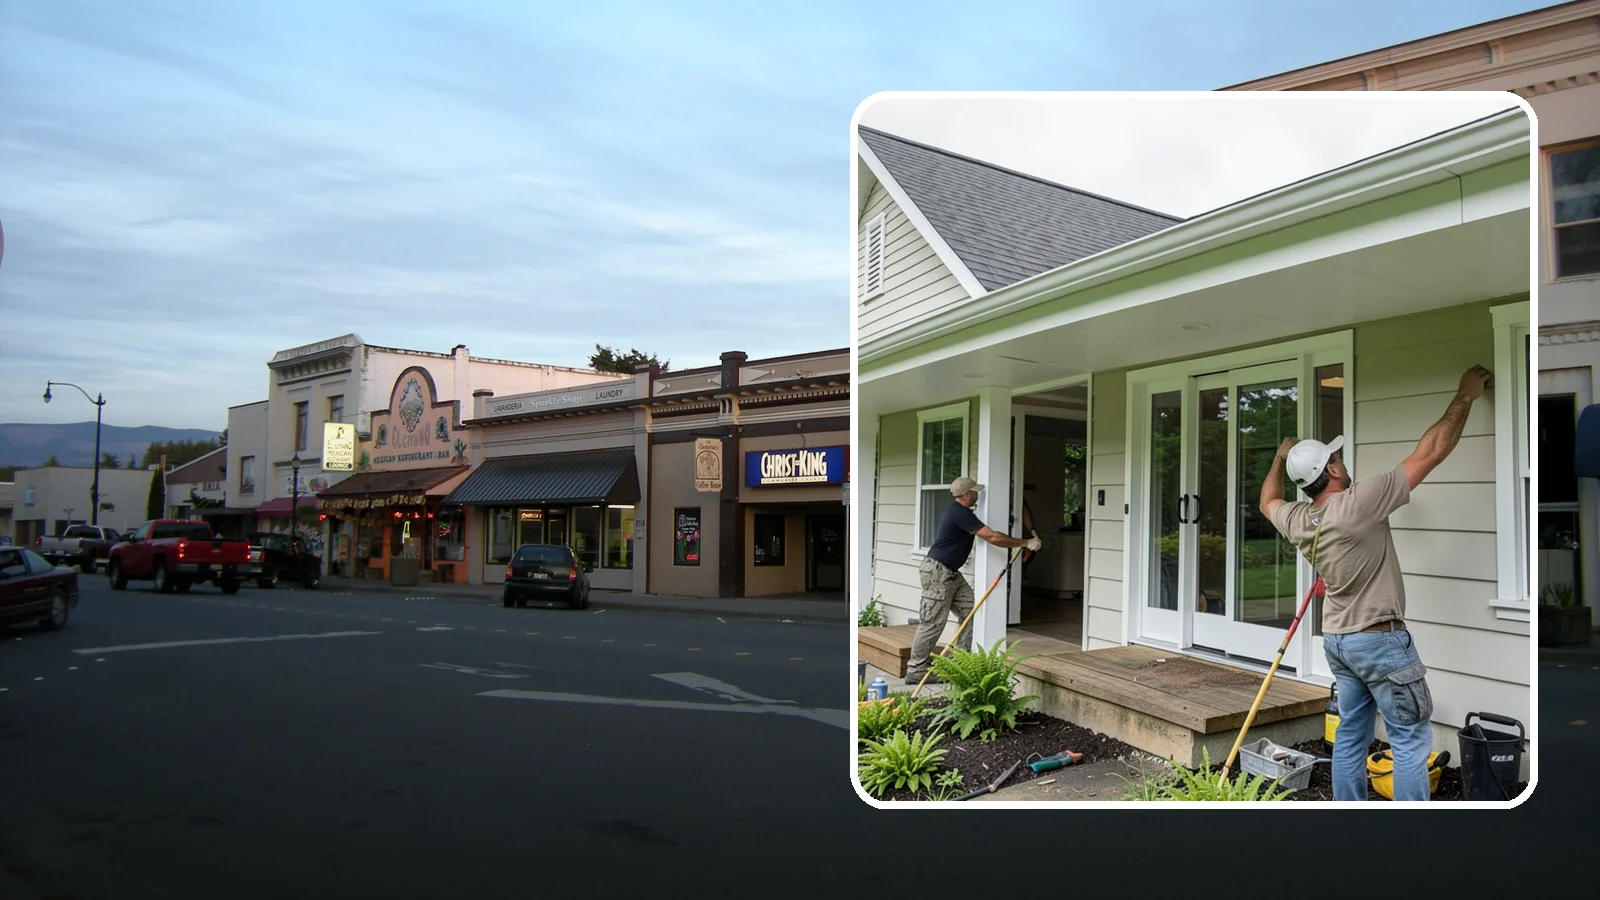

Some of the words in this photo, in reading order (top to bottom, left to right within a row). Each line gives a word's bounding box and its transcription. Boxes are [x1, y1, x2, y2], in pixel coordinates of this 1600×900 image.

[493, 402, 522, 413] LAVANDERIA
[531, 398, 560, 409] Sparkle
[561, 395, 582, 405] Shop
[595, 389, 623, 400] LAUNDRY
[373, 454, 396, 464] MEXICAN
[397, 451, 434, 462] RESTAURANT
[438, 449, 450, 459] BAR
[761, 452, 797, 477] CHRIST
[799, 449, 827, 477] KING
